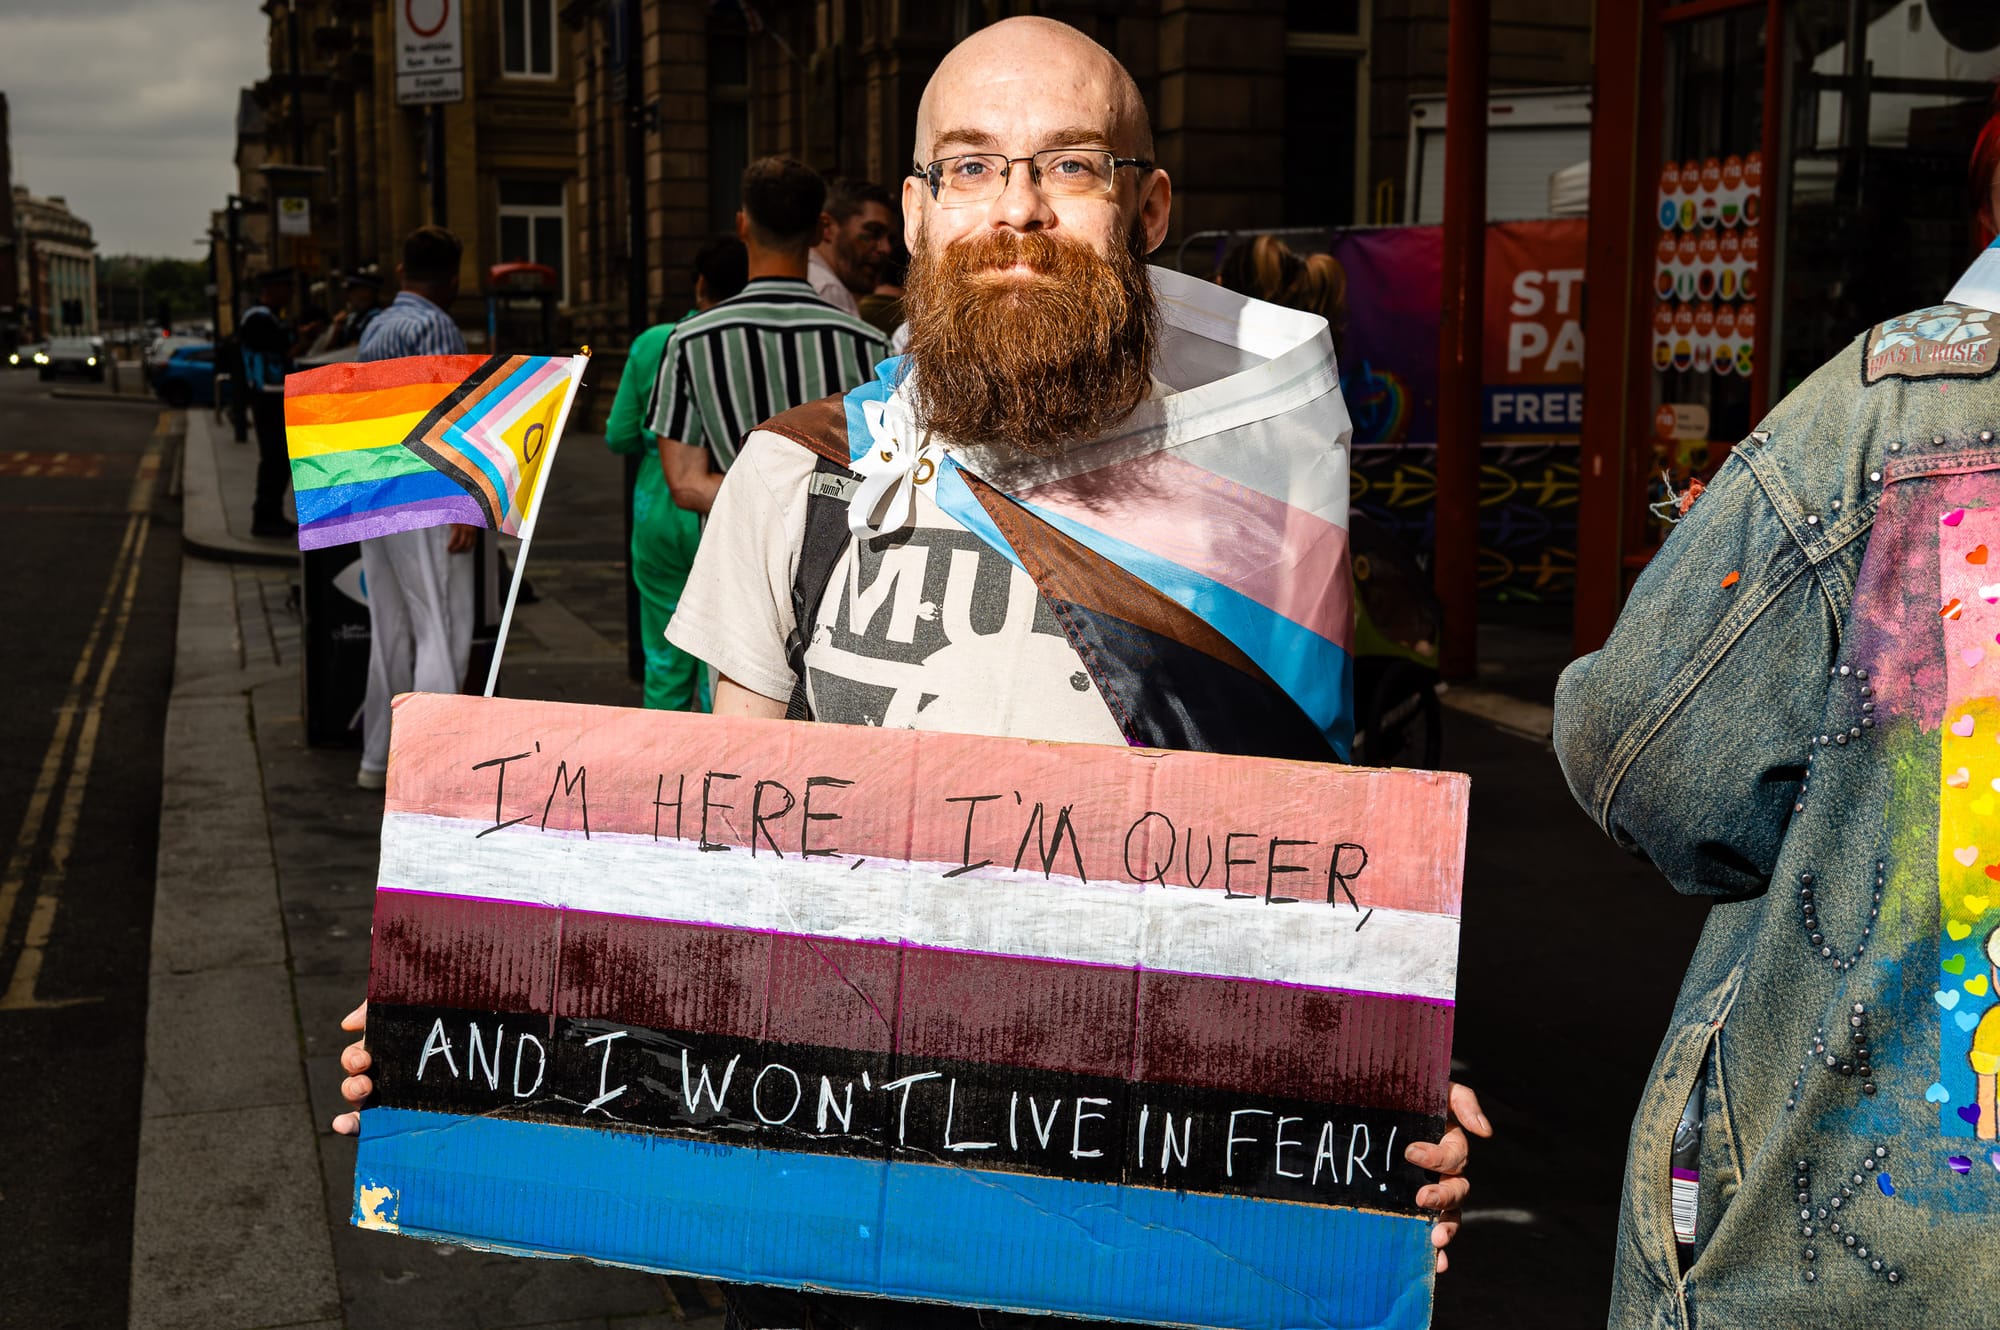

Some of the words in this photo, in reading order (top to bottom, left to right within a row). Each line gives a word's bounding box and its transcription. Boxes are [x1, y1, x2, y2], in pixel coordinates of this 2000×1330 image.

[1507, 320, 1585, 372] PA
[1930, 343, 1988, 363] ROSES
[472, 741, 590, 840] I'M
[653, 771, 865, 870] HERE,
[942, 791, 1087, 884] I'M
[1124, 811, 1373, 932] QUEER,
[416, 1017, 547, 1098] AND
[583, 1030, 628, 1113] I
[681, 1048, 943, 1146] WON'T
[944, 1078, 1112, 1159] LIVE
[1138, 1104, 1193, 1175] IN
[1226, 1109, 1398, 1192] FEAR!
